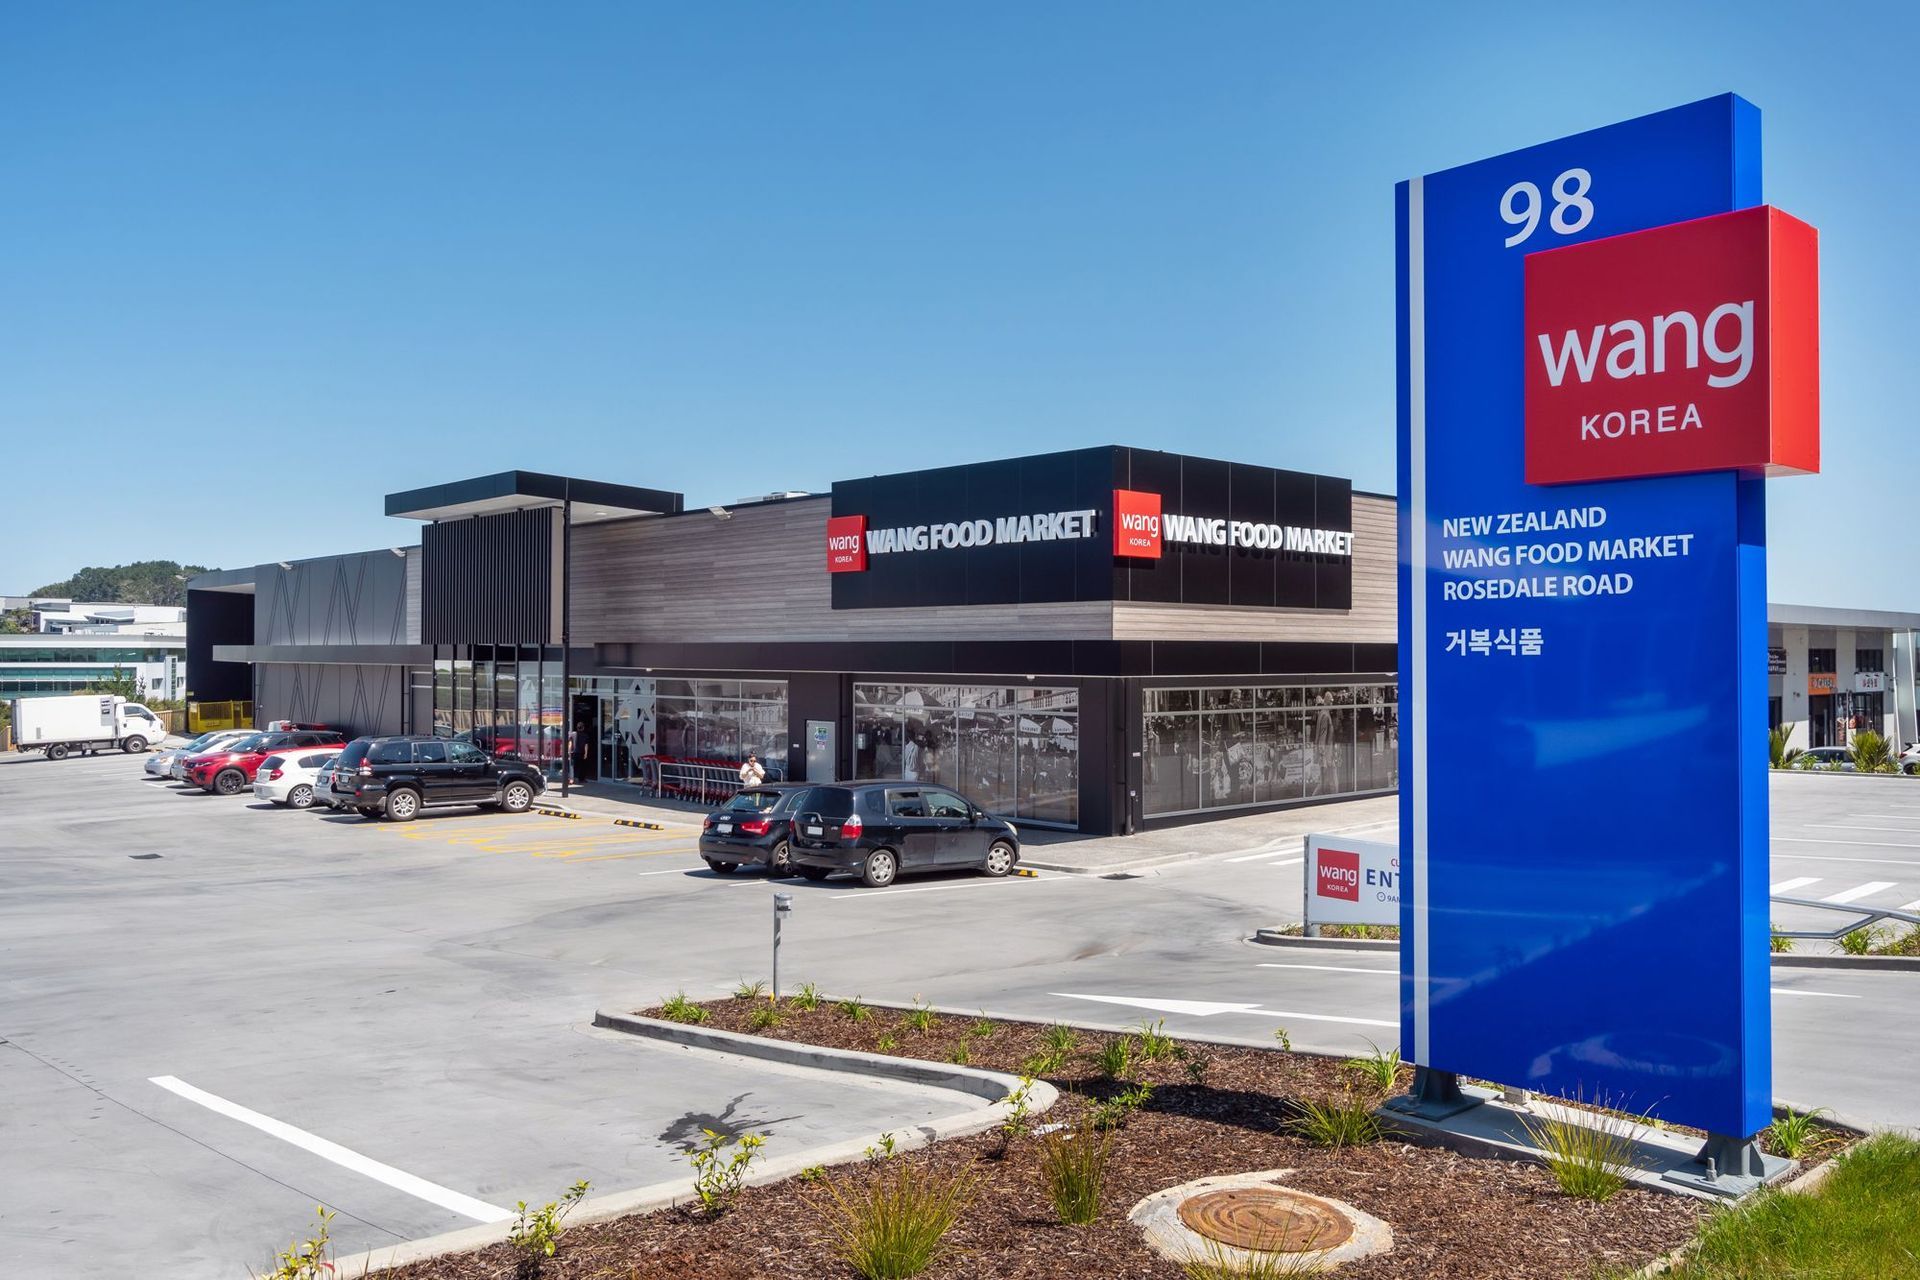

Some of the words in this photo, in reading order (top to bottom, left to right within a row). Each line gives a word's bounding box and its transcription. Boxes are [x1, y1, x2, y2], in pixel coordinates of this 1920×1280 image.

[1500, 168, 1594, 248] 98
[1538, 300, 1754, 388] wang
[1581, 403, 1703, 440] KOREA
[866, 526, 928, 554] WANG
[930, 519, 993, 550] FOOD
[996, 509, 1096, 544] MARKET
[1121, 512, 1159, 537] wang
[1161, 514, 1226, 545] WANG
[1227, 520, 1283, 549] FOOD
[1283, 526, 1354, 556] MARKET
[1443, 516, 1492, 538] NEW
[1496, 506, 1607, 534] ZEALAND
[829, 533, 860, 555] wang
[1129, 538, 1151, 547] KOREA
[1443, 547, 1510, 569] WANG
[1516, 542, 1583, 565] FOOD
[1588, 534, 1694, 561] MARKET
[1443, 576, 1557, 600] ROSEDALE
[1563, 573, 1634, 596] ROAD
[1445, 627, 1544, 656] 거복식품
[1320, 865, 1357, 887] wang
[1327, 884, 1349, 893] KOREA
